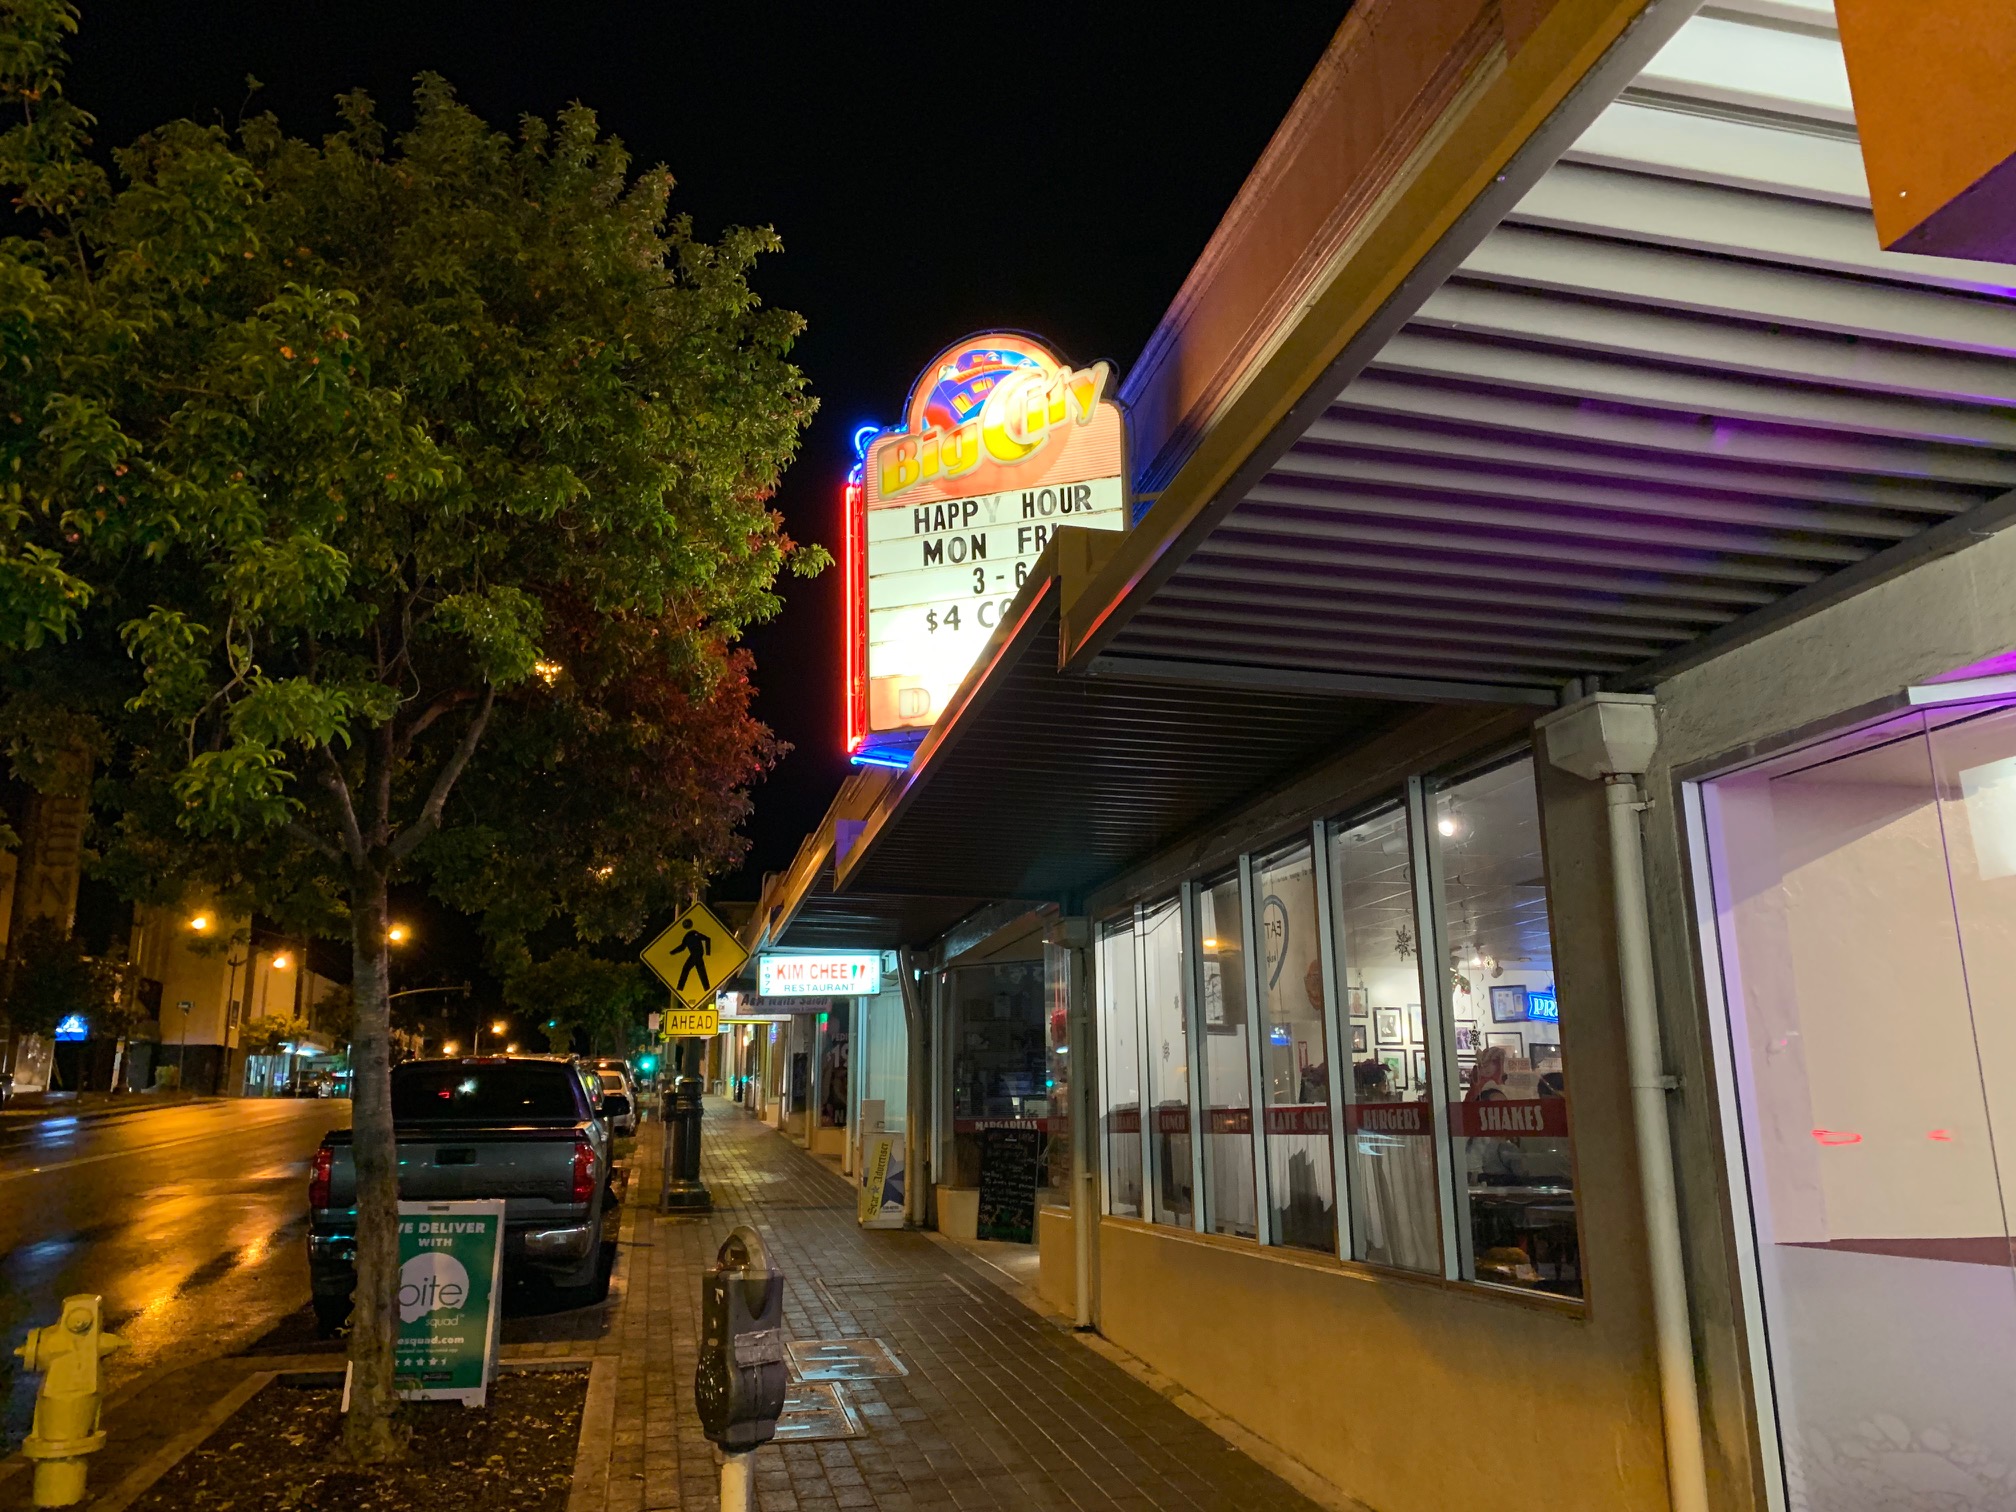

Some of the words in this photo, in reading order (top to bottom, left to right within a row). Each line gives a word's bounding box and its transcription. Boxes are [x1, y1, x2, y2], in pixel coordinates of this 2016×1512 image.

[877, 420, 982, 498] Big
[983, 362, 1110, 465] City
[914, 496, 1001, 534] HAPPY
[1022, 485, 1093, 519] HOUR
[923, 533, 987, 567] MON
[926, 604, 962, 634] $4
[777, 964, 803, 980] KIM
[810, 963, 847, 979] CHEE
[784, 984, 855, 992] RESTAURANT
[671, 1015, 713, 1030] AHEAD
[1270, 1111, 1297, 1130] LATE
[1362, 1108, 1421, 1130] BURGERS
[1479, 1104, 1544, 1131] SHAKES
[418, 1222, 486, 1234] DELIVER
[418, 1238, 453, 1247] WITH
